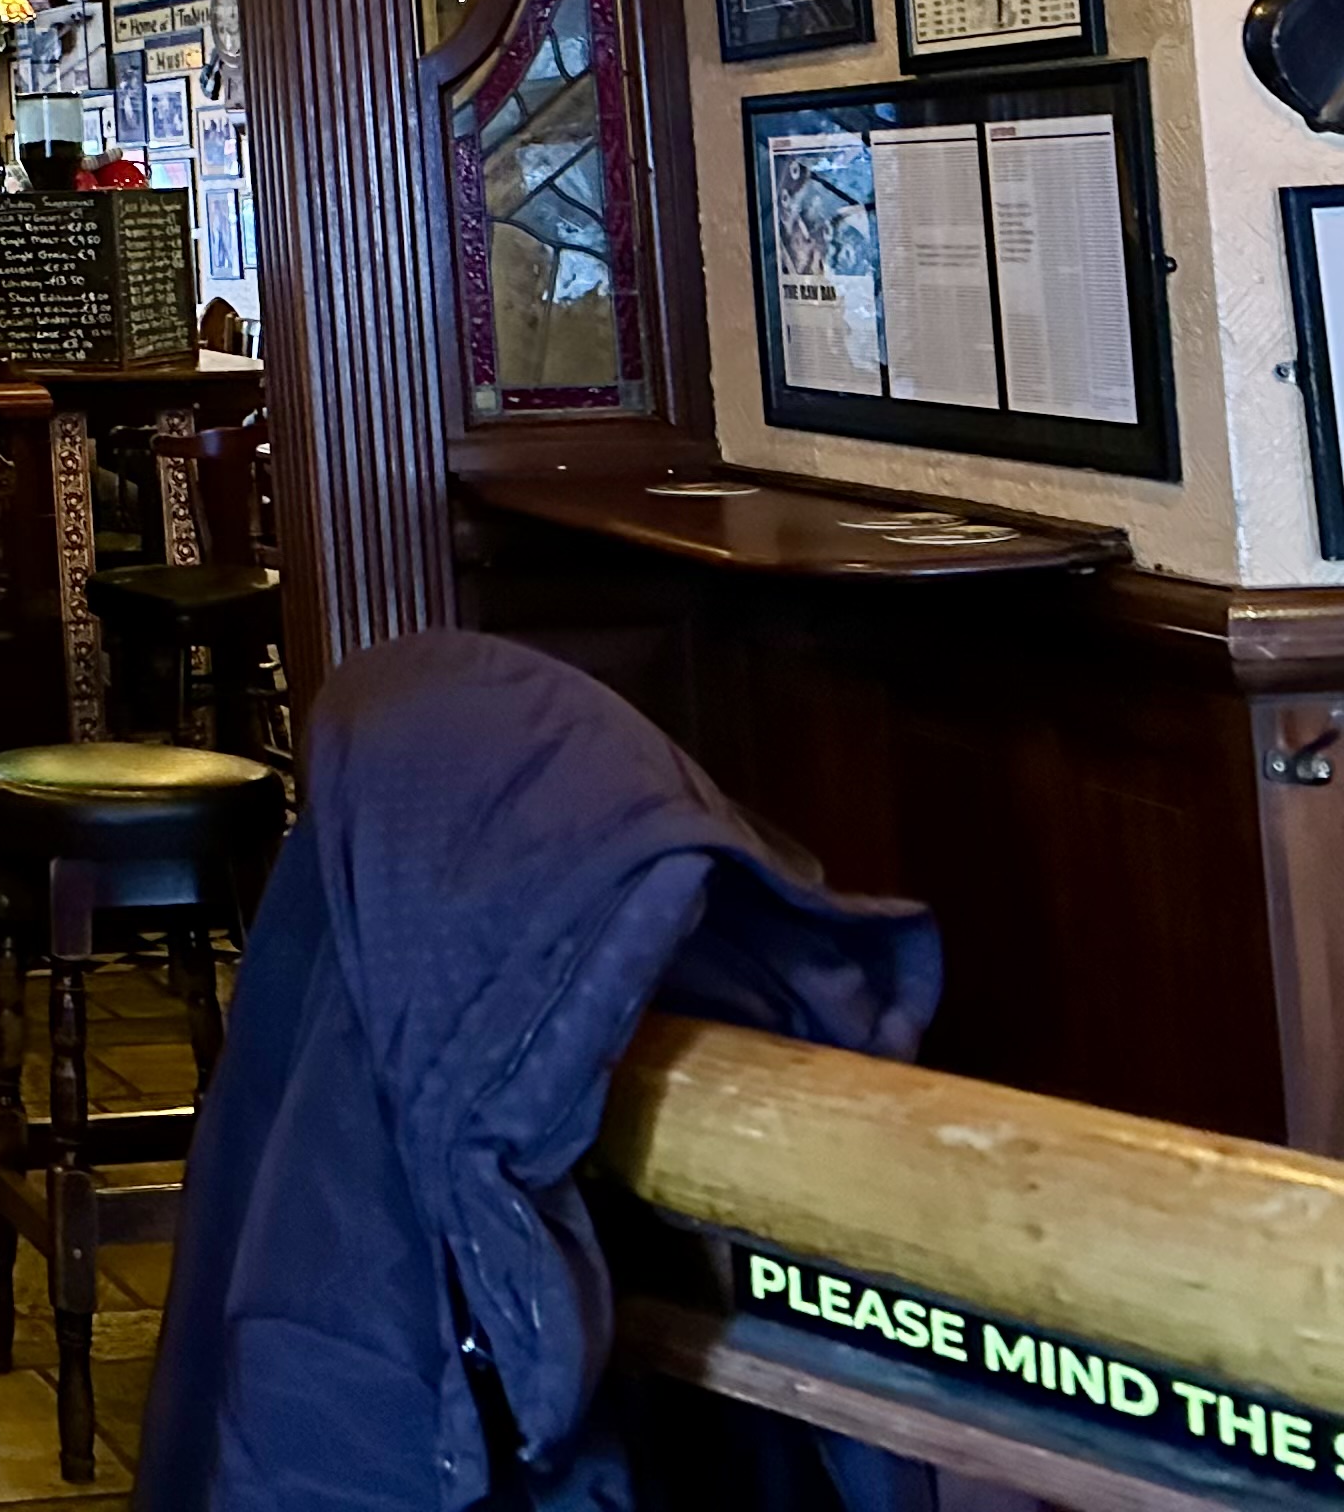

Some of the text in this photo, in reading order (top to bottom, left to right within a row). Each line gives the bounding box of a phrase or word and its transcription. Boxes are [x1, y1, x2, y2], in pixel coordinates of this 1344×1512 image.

[749, 1255, 969, 1363] PLEASE
[982, 1324, 1160, 1418] MIND
[1172, 1380, 1317, 1471] THE
